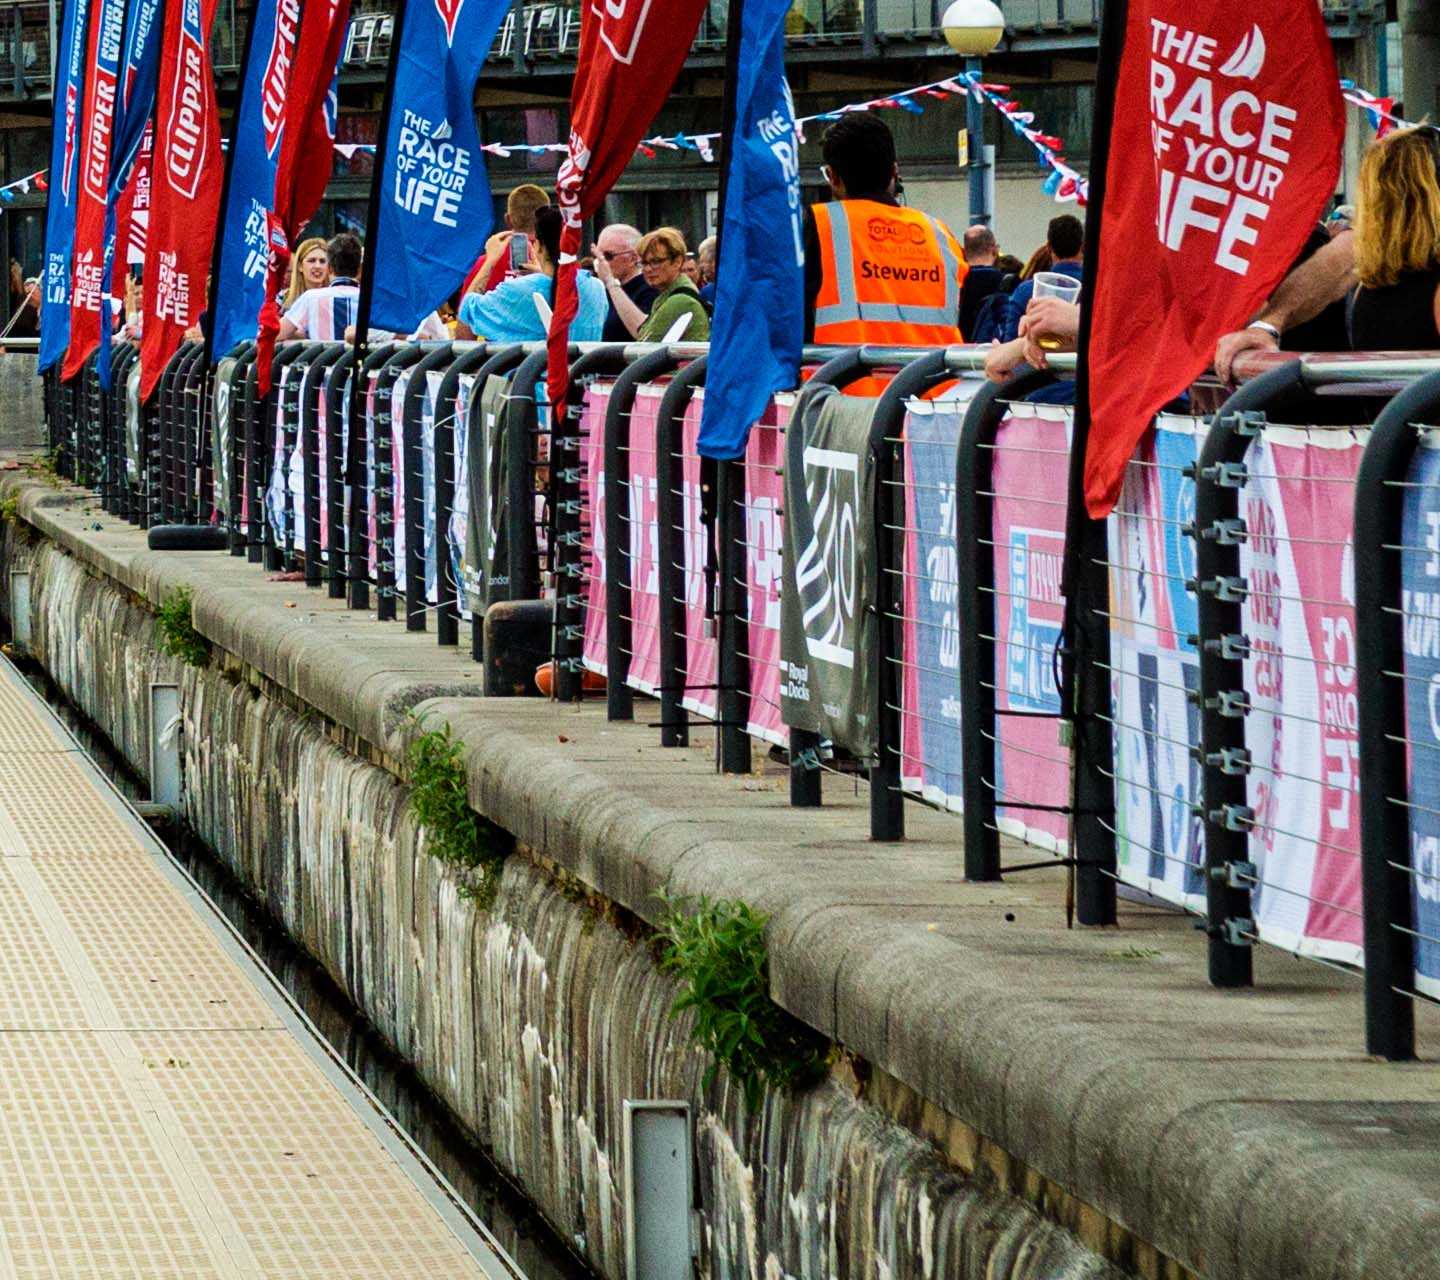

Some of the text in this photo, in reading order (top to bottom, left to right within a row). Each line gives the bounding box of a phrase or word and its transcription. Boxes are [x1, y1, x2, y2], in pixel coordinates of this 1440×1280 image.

[1150, 17, 1218, 73] THE
[87, 79, 117, 188] CLIPPER
[169, 45, 204, 180] CLIPPER
[403, 109, 432, 138] THE
[1150, 58, 1298, 165] RACE
[397, 155, 466, 193] OF YOUR
[398, 126, 470, 177] RACE
[1183, 135, 1285, 201] YOUR
[394, 170, 463, 228] LIFE
[76, 265, 101, 281] ACE
[861, 260, 940, 284] Steward
[787, 659, 809, 683] Royal
[787, 683, 811, 702] Docks
